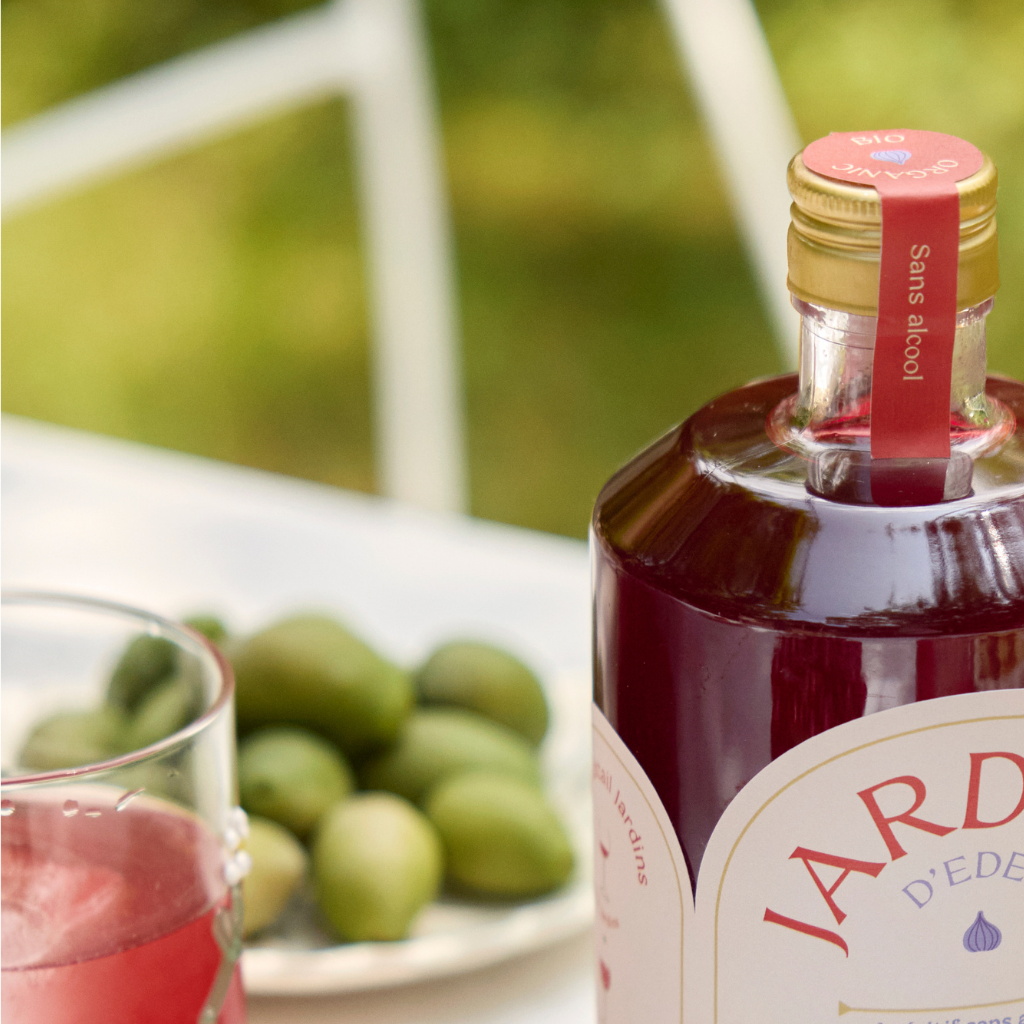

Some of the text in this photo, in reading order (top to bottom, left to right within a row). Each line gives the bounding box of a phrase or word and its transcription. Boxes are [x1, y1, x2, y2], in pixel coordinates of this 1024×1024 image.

[850, 134, 905, 146] BIO
[831, 159, 959, 180] ORGANIC
[902, 244, 931, 381] Sans alcool
